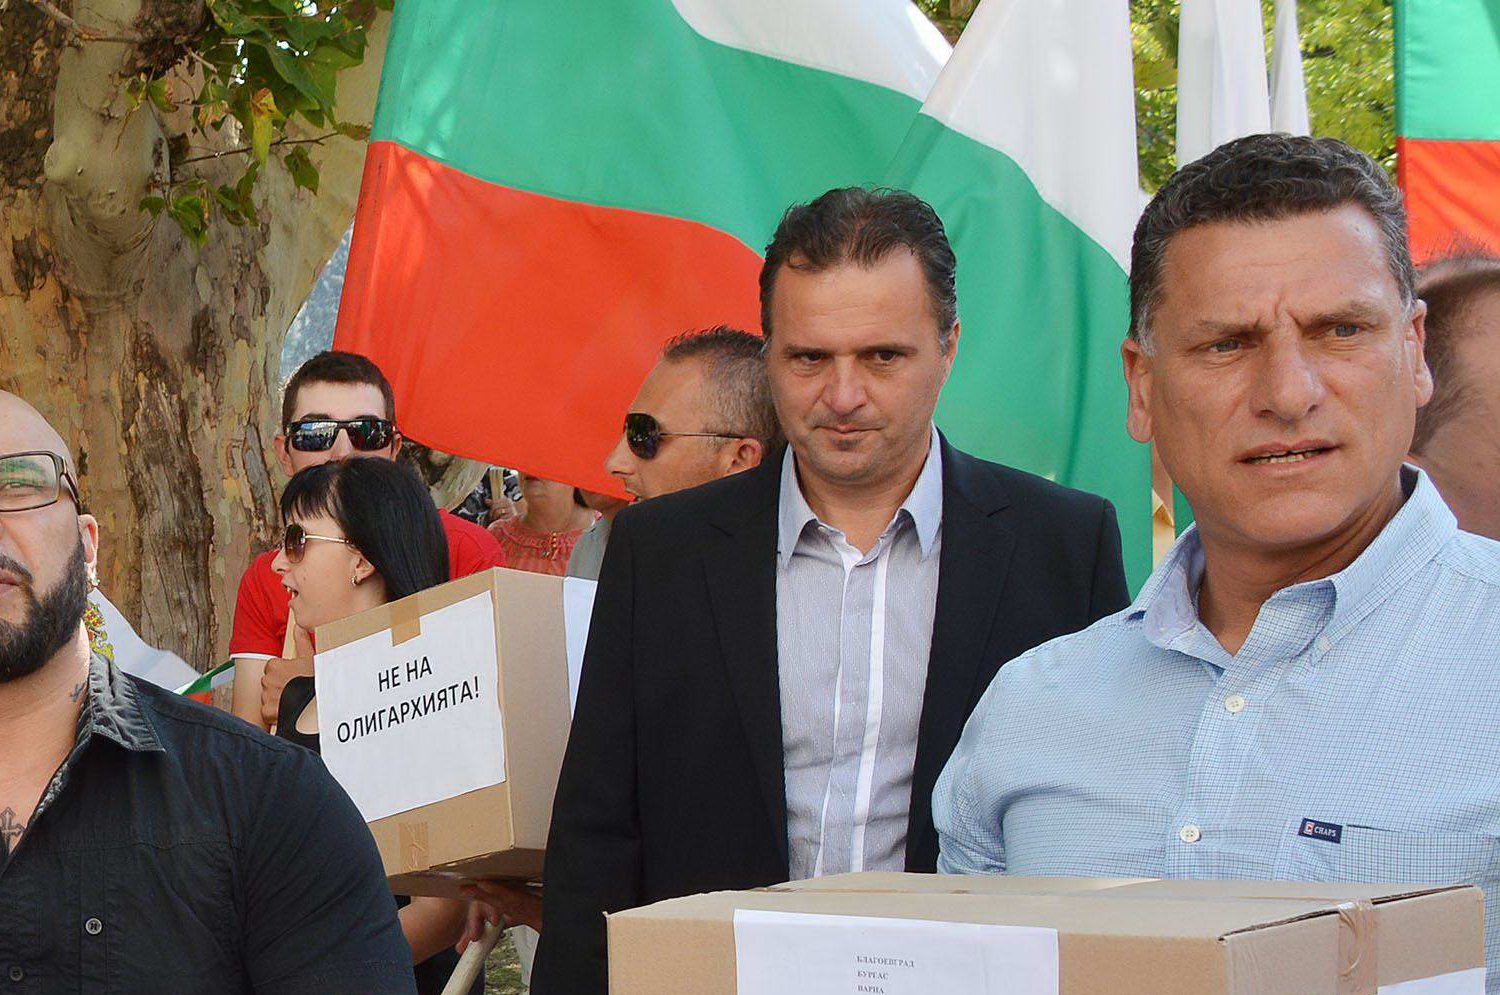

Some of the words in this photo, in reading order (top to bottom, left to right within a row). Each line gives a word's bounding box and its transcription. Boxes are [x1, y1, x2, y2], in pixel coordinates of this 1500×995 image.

[378, 666, 400, 693] НЕ
[406, 656, 432, 682] НА
[337, 676, 480, 744] ОЛИГАРХИЯТА!
[1314, 826, 1336, 837] CHAPS
